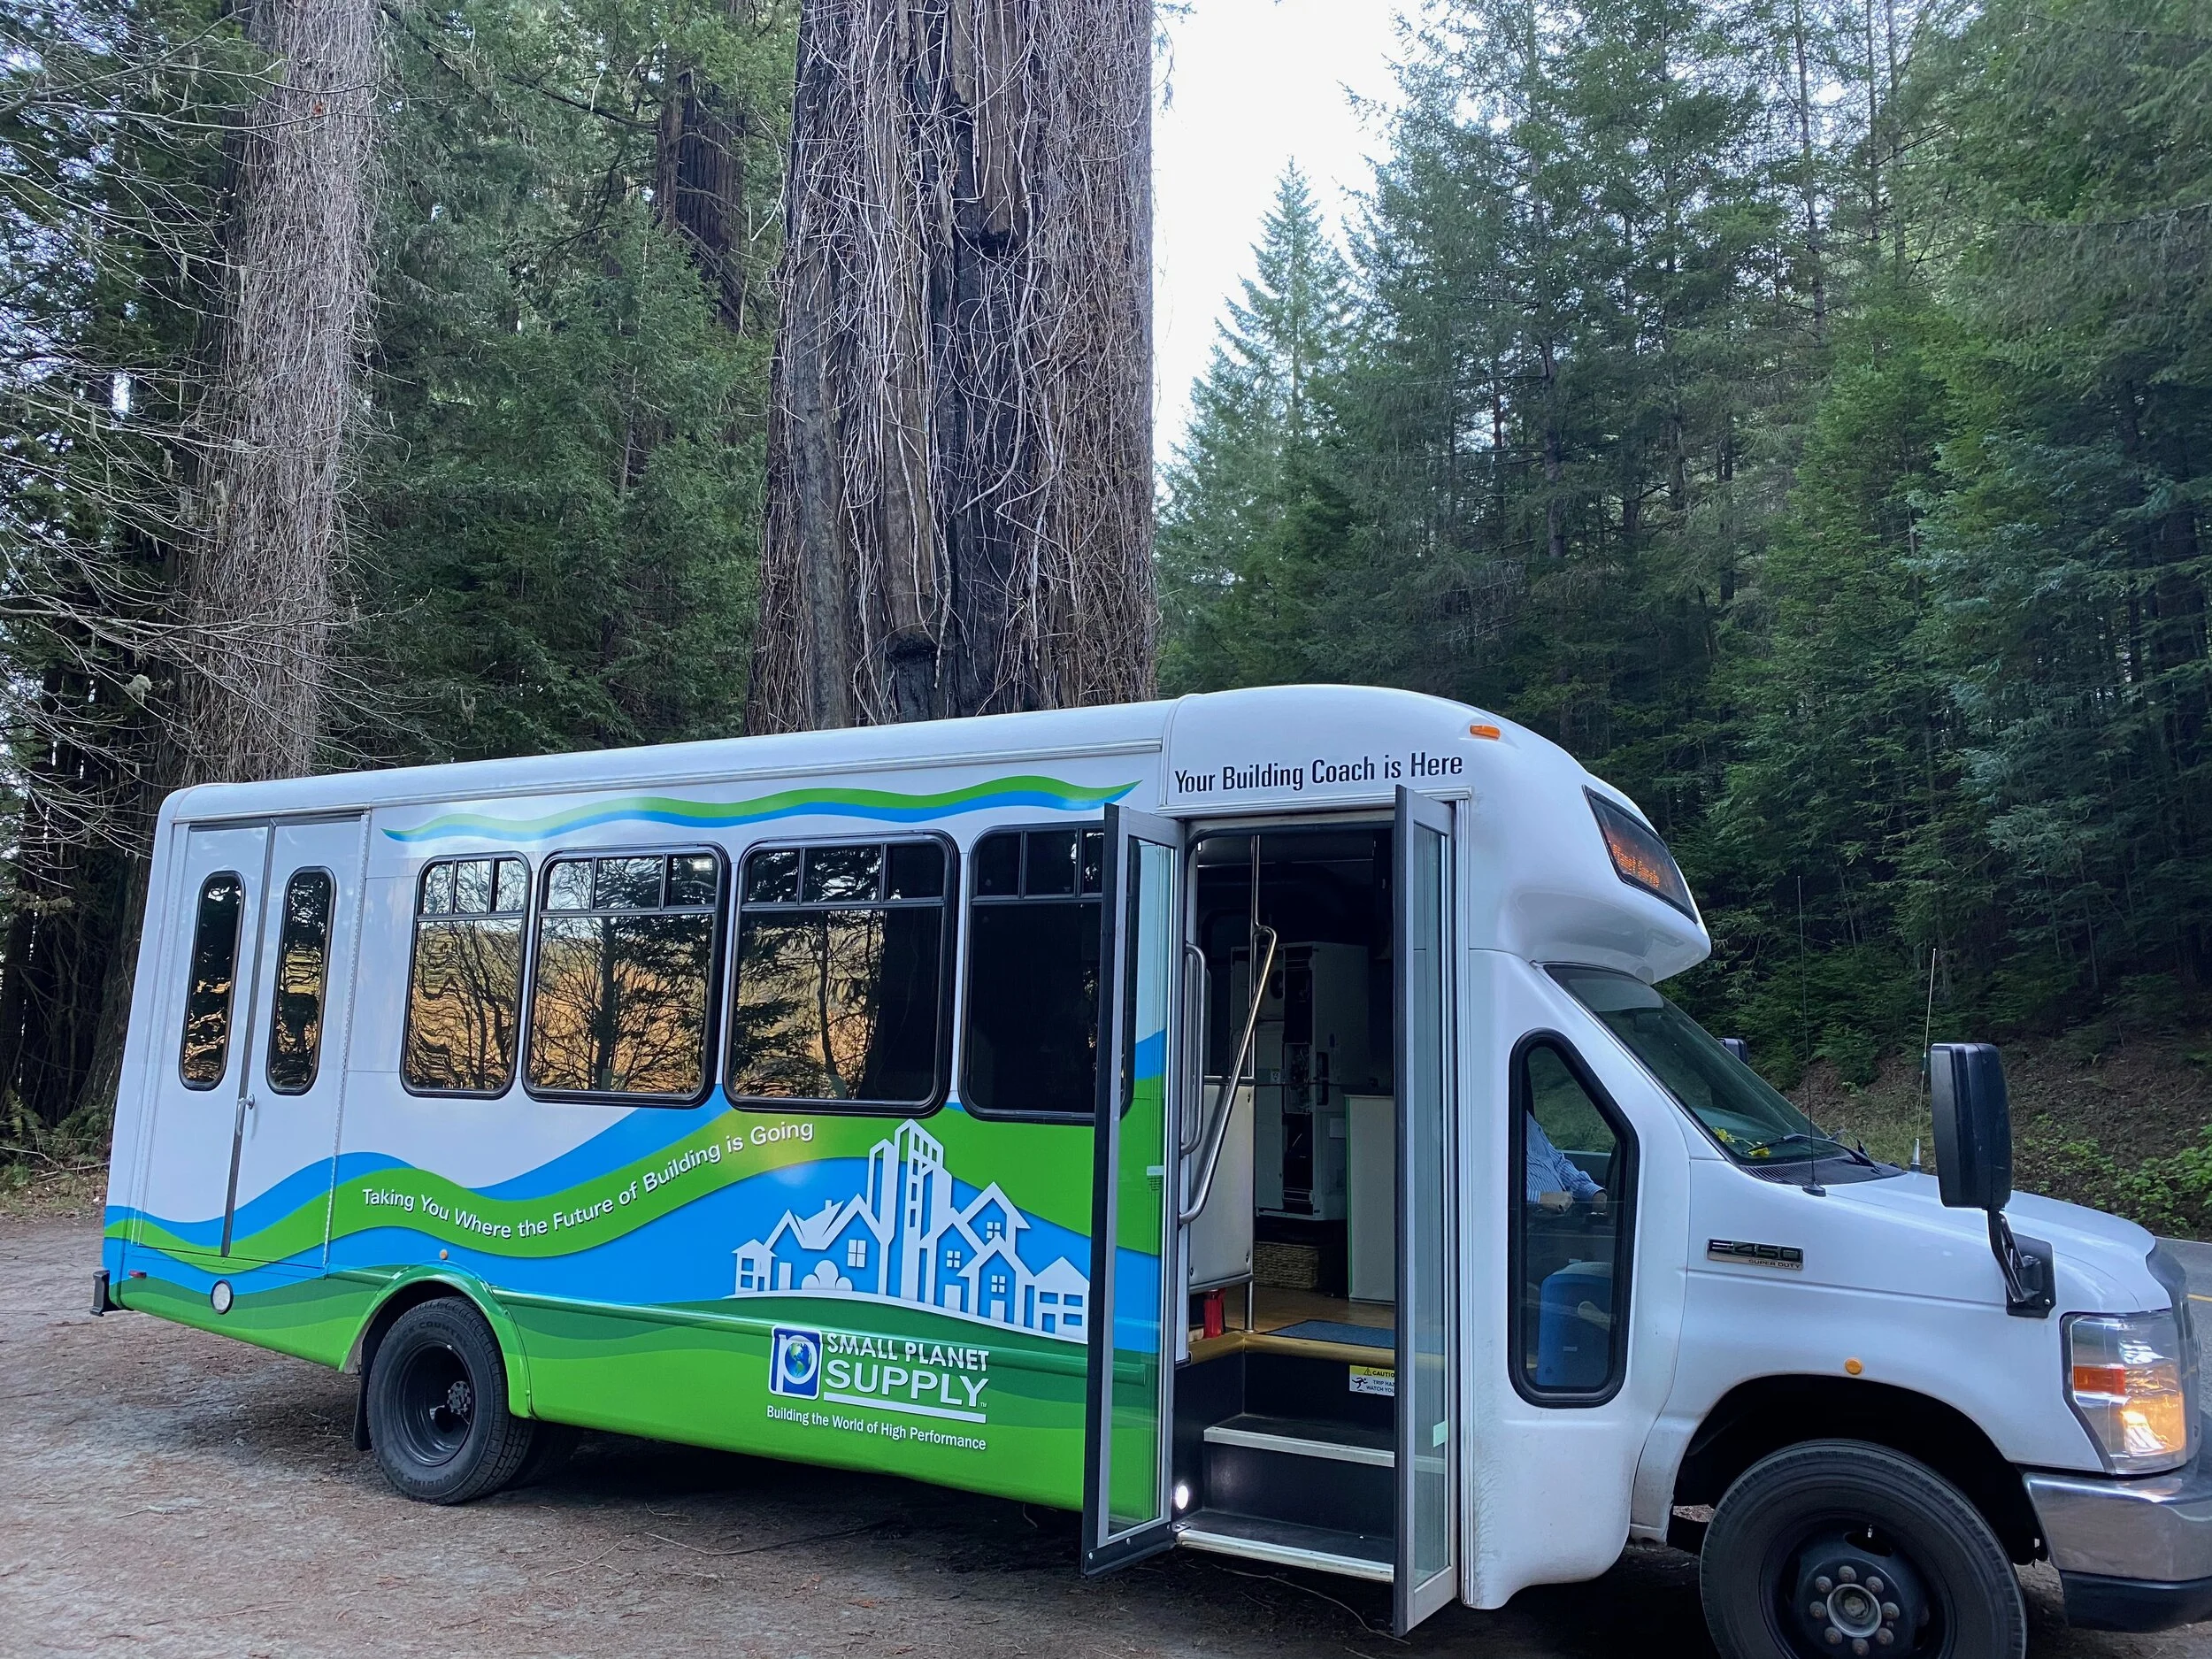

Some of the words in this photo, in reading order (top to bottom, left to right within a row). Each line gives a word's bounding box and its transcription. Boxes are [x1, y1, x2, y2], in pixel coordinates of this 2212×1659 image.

[1175, 769, 1216, 794] Your
[1222, 763, 1303, 792] Building
[1312, 756, 1375, 784] Coach
[1384, 754, 1402, 780] is
[1410, 752, 1463, 778] Here
[362, 1188, 415, 1212] Taking
[420, 1194, 449, 1220] You
[454, 1208, 511, 1239] Where
[517, 1220, 548, 1238] the
[553, 1196, 614, 1231] Future
[618, 1186, 639, 1207] of
[642, 1144, 723, 1194] Building
[726, 1133, 744, 1154] is
[750, 1121, 814, 1144] Going
[826, 1333, 898, 1361] SMALL
[904, 1341, 990, 1371] PLANET
[825, 1359, 989, 1408] SUPPLY
[767, 1405, 809, 1426] Building
[811, 1412, 829, 1426] the
[832, 1416, 864, 1432] World
[866, 1421, 878, 1434] of
[880, 1424, 907, 1440] High
[910, 1426, 987, 1450] Performance
